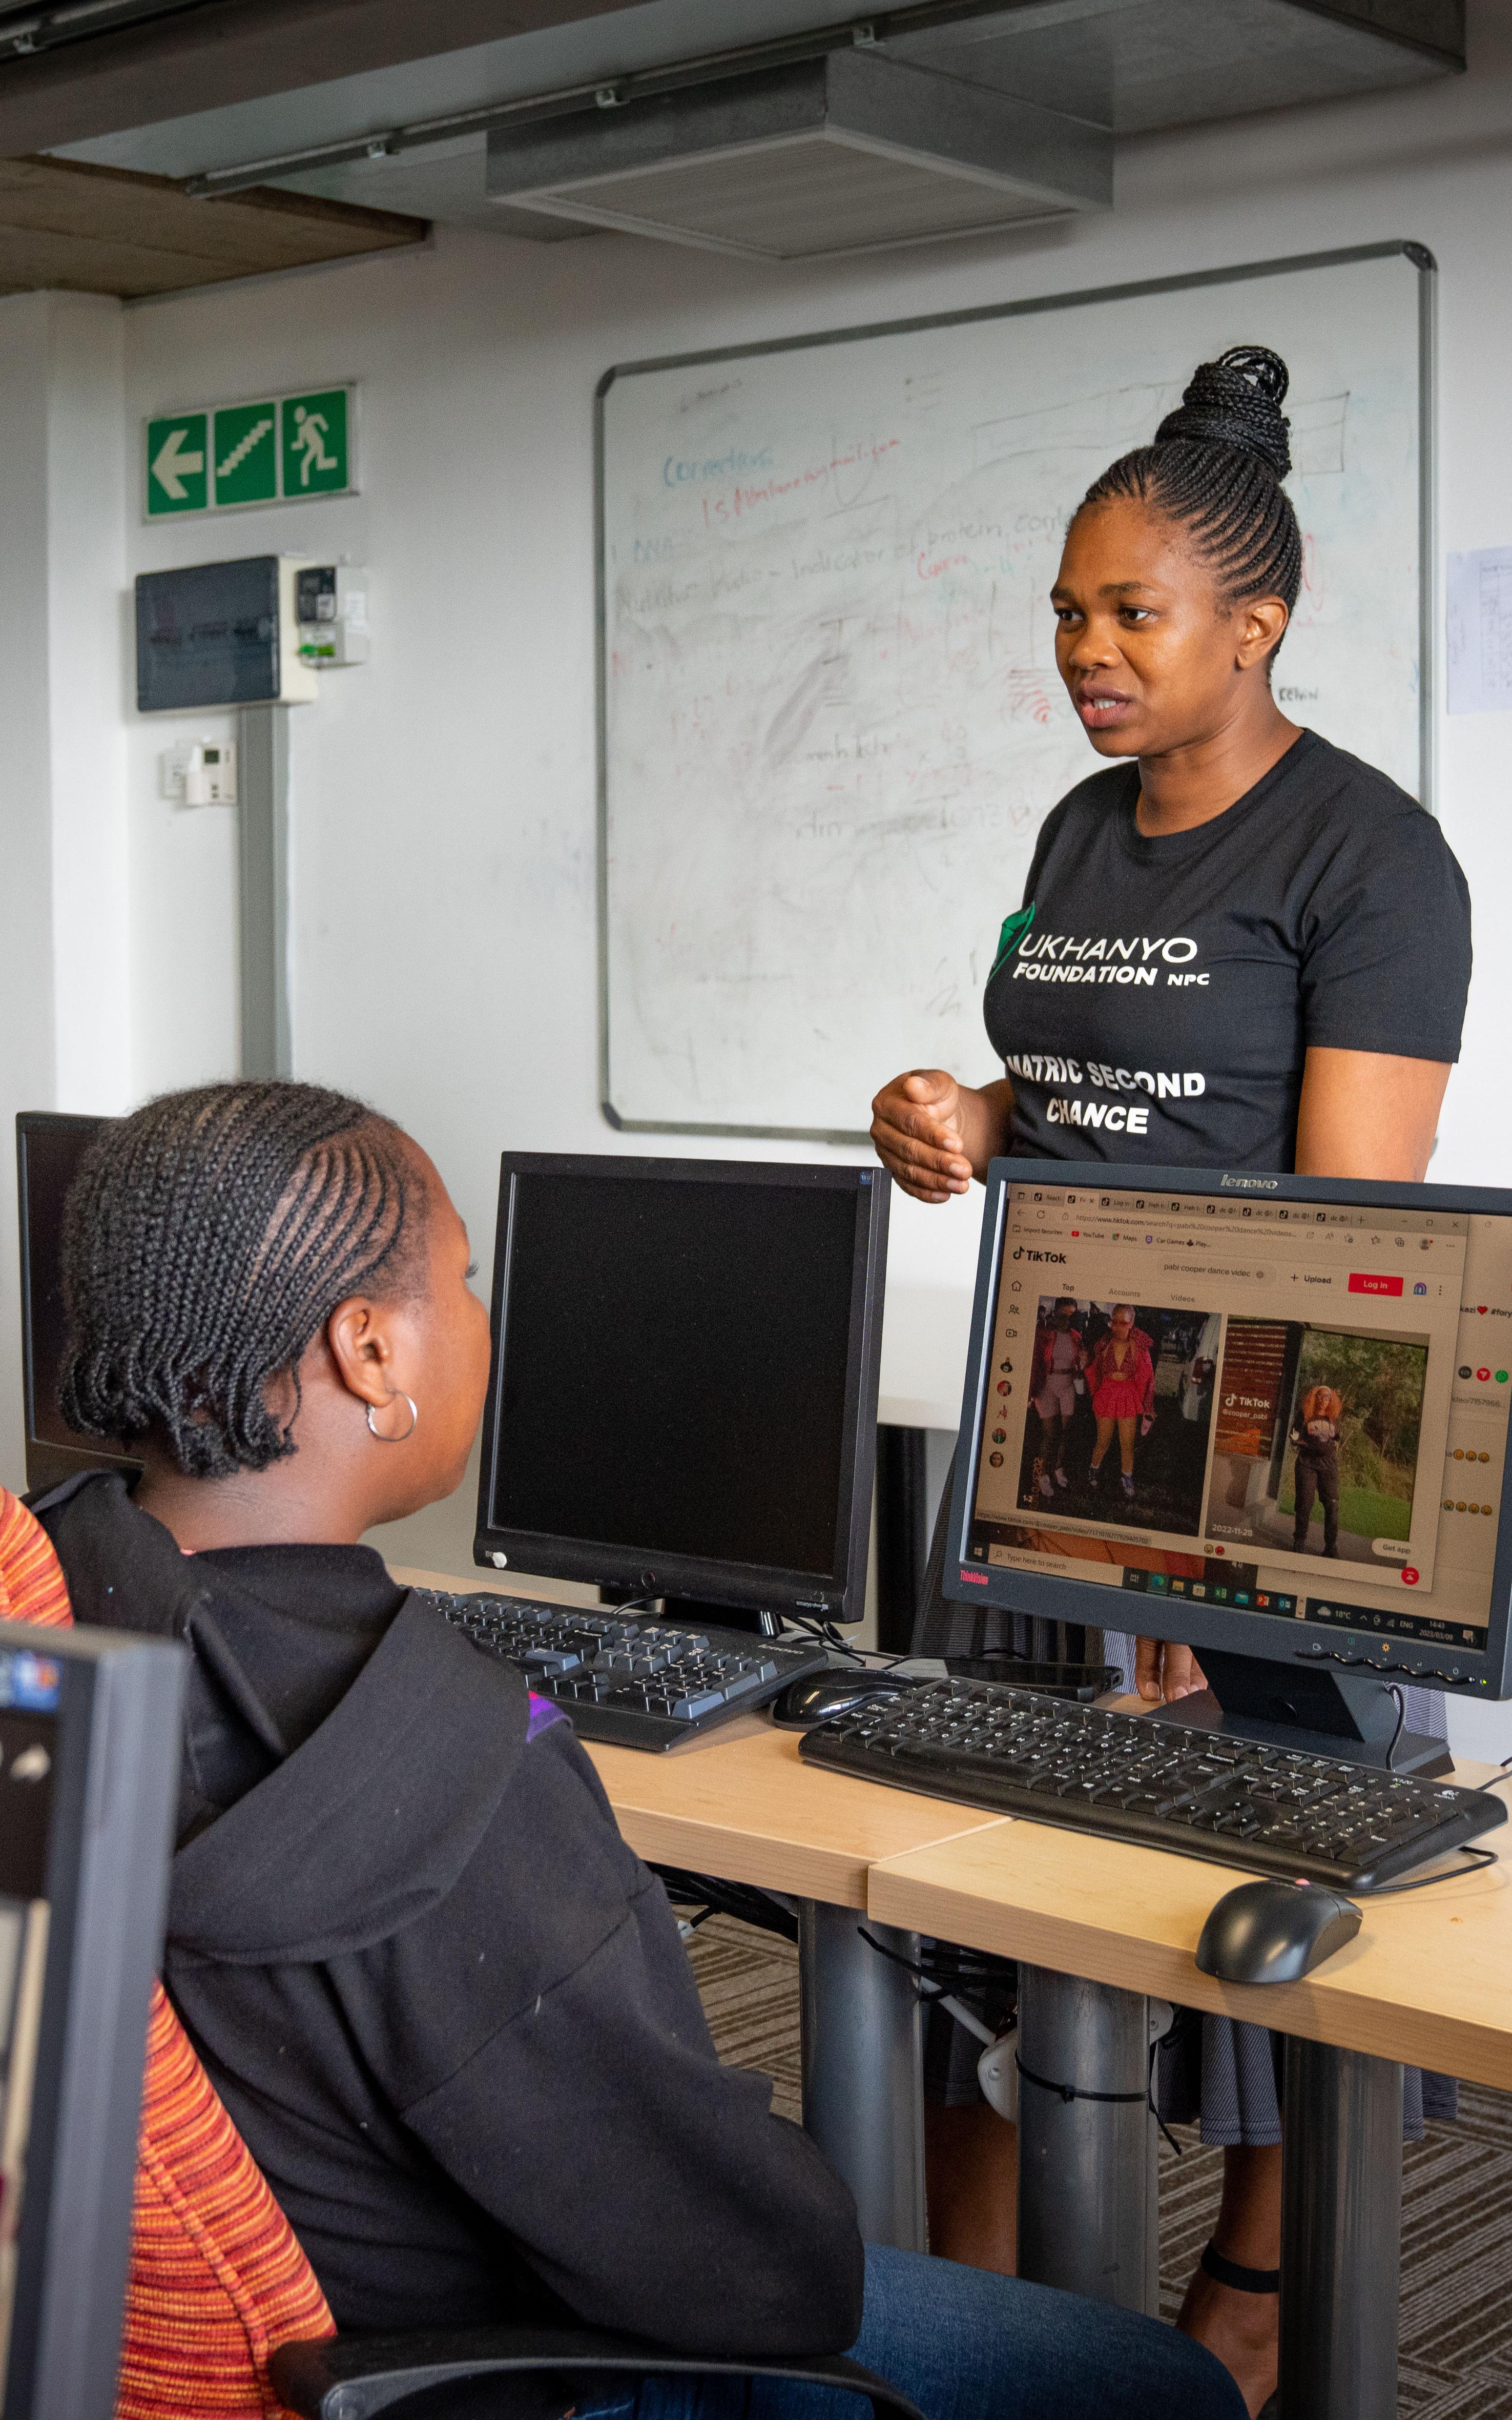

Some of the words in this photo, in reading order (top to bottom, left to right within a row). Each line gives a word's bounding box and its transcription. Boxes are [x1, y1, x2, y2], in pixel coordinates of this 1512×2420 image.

[1018, 933, 1198, 963] UKHANYO
[1013, 962, 1158, 986] FOUNDATION
[1167, 973, 1210, 986] NPC
[1006, 1055, 1083, 1083] MATRIC
[1086, 1061, 1206, 1098] SECOND
[1047, 1098, 1149, 1134] CHANCE
[1220, 1174, 1278, 1190] lenovo
[1026, 1249, 1066, 1264] TikTok
[1164, 1263, 1179, 1271] pabi
[1180, 1264, 1206, 1274] cooper
[1303, 1274, 1332, 1285] Upload
[1363, 1279, 1378, 1290] Log
[1380, 1281, 1387, 1289] in
[1062, 1283, 1074, 1292] Top
[1108, 1288, 1141, 1298] Accounts
[1170, 1295, 1195, 1303] Videos
[1239, 1397, 1270, 1408] TikTok
[1383, 1544, 1395, 1553] Get
[1398, 1547, 1411, 1555] app
[1007, 1553, 1019, 1563] Type
[1022, 1555, 1036, 1564] here
[1046, 1560, 1066, 1569] search
[1400, 1620, 1414, 1629] ENG
